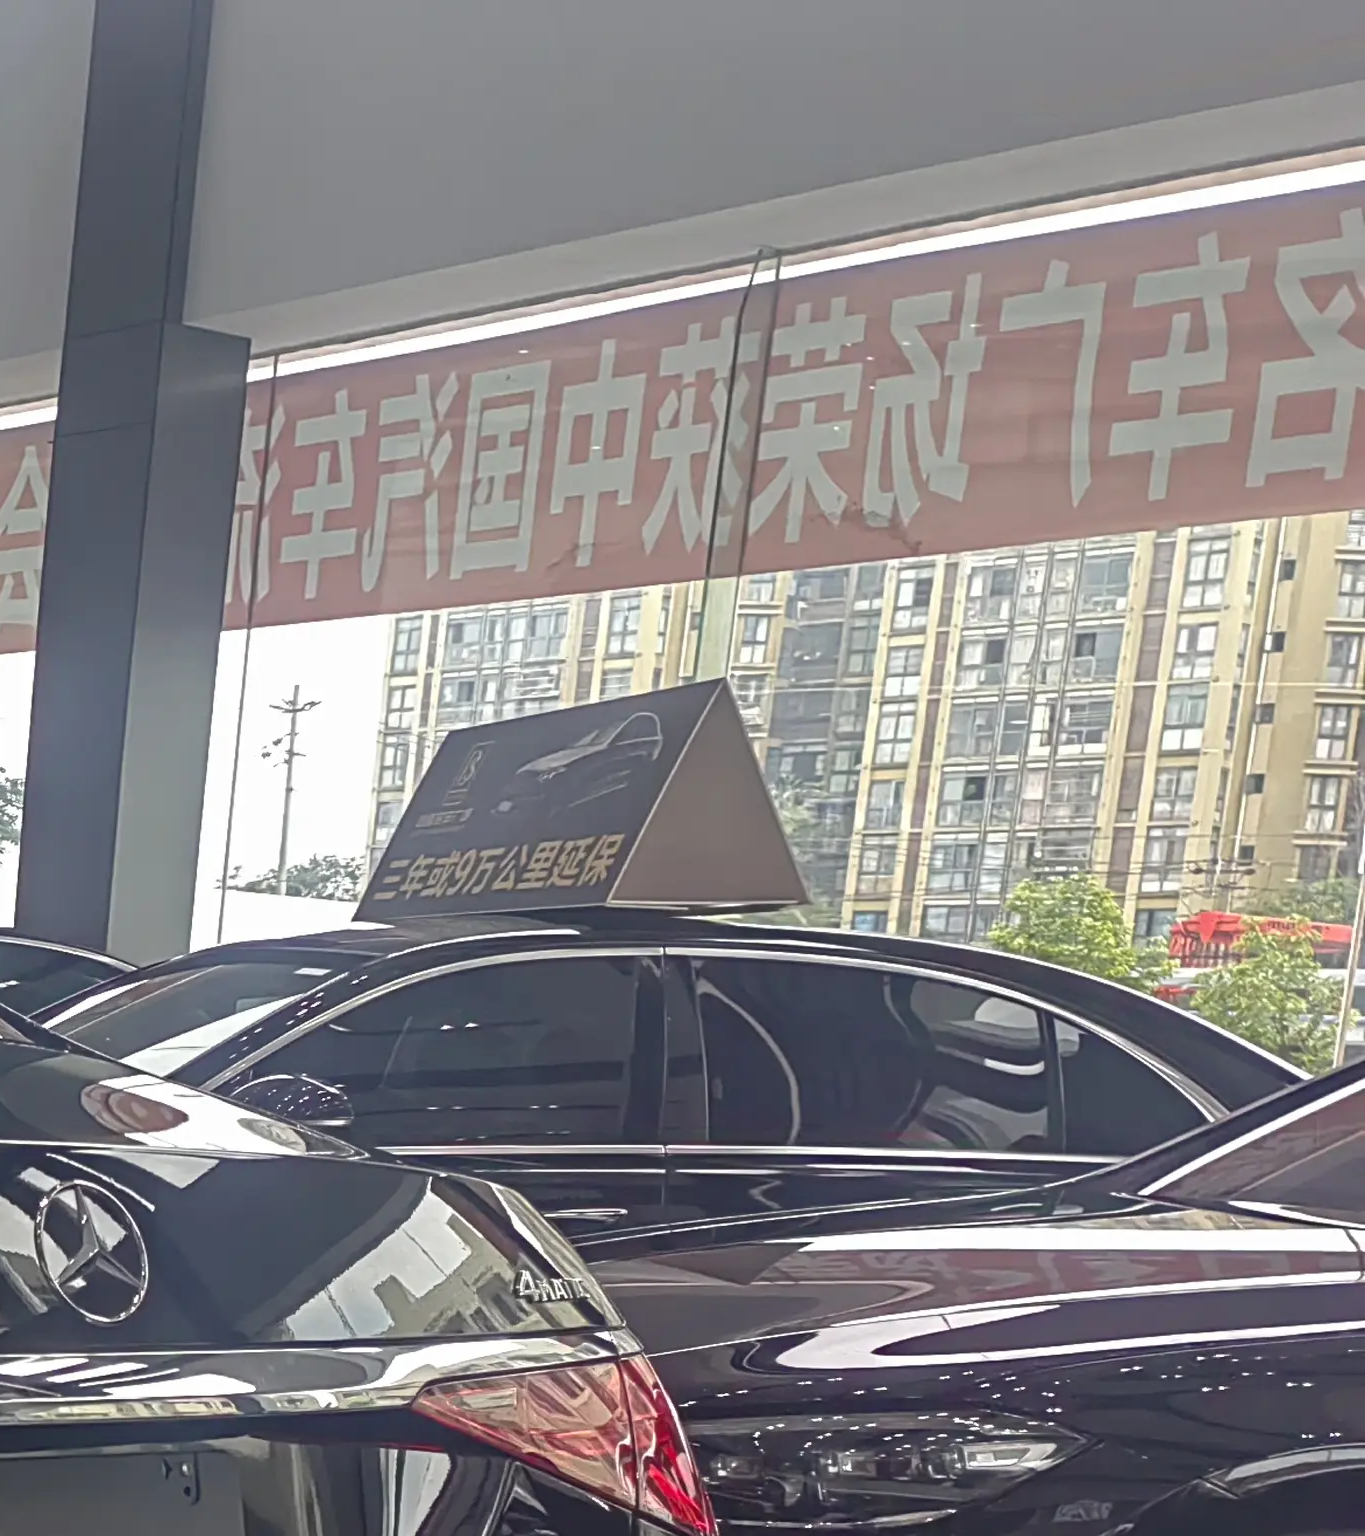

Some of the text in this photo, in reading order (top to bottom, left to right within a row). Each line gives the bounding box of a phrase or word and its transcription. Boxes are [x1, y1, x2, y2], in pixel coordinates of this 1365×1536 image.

[373, 834, 625, 899] 三年或9万公里延保
